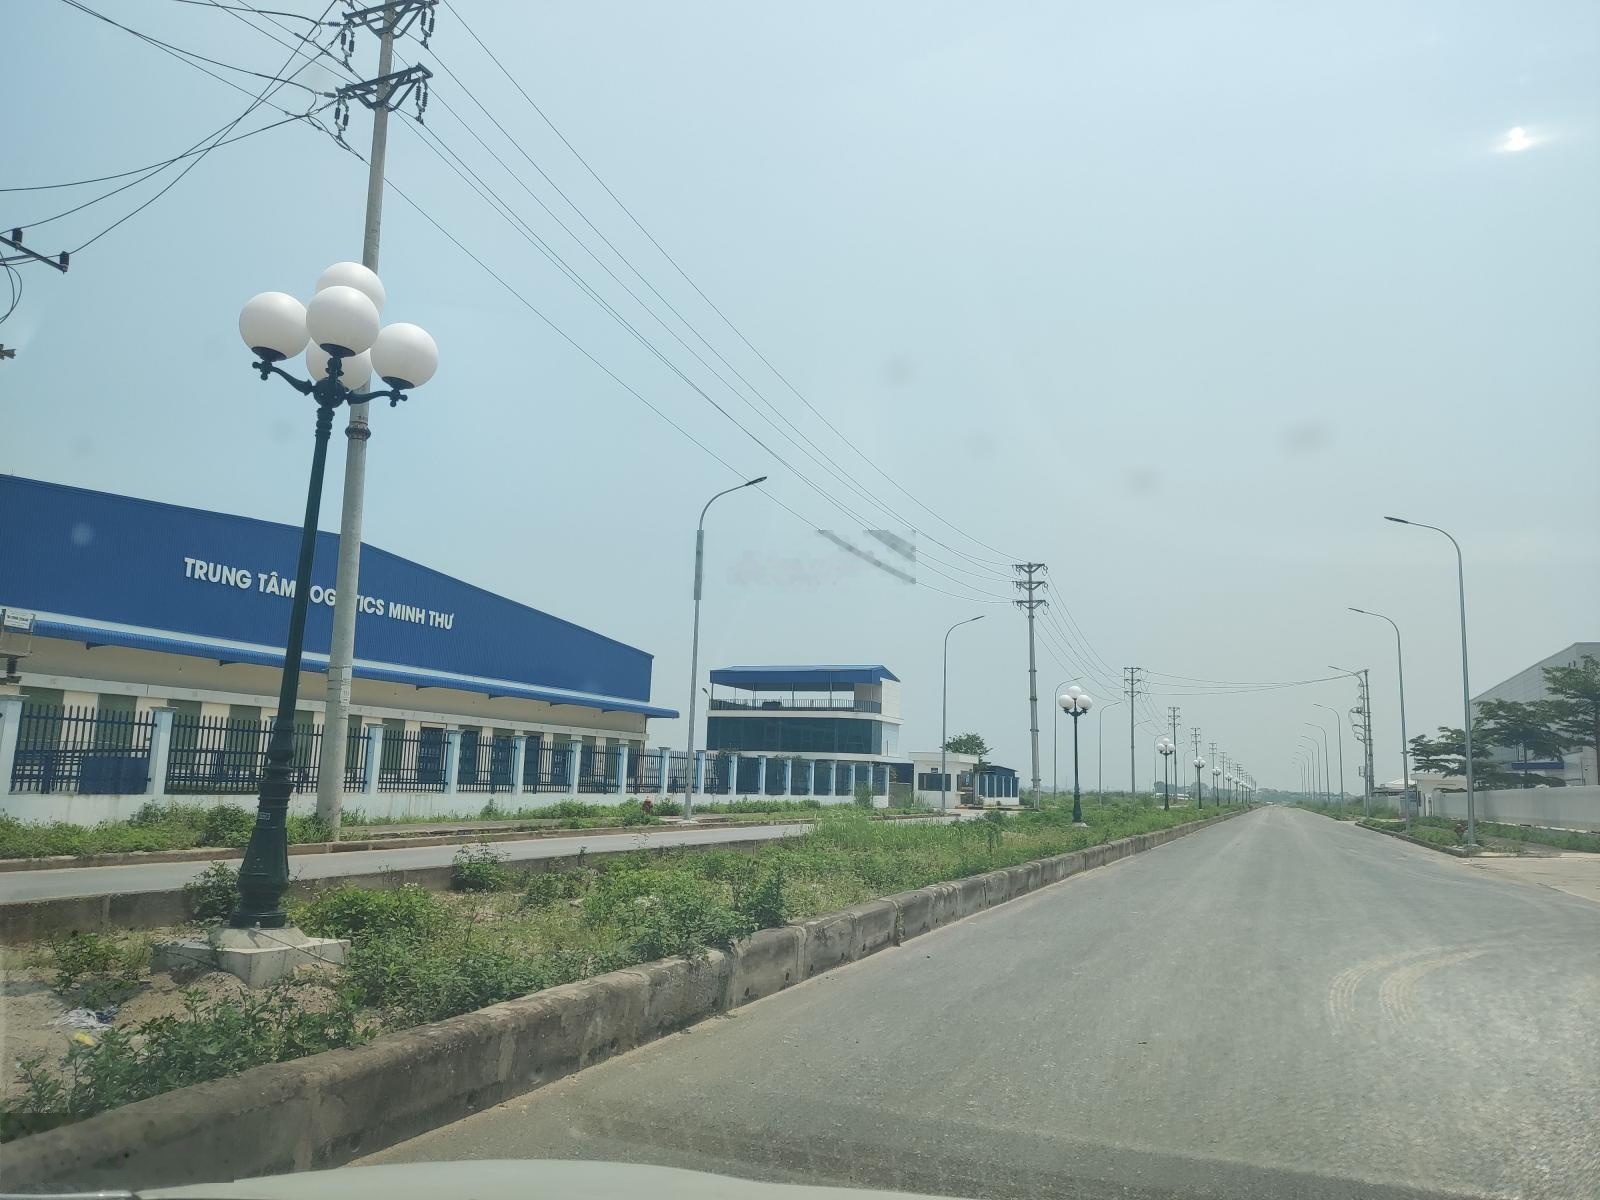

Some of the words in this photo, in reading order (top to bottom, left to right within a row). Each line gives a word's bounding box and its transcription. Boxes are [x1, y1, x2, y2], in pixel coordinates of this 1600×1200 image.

[184, 557, 252, 589] TRUNG
[258, 571, 297, 598] TÂM
[310, 585, 385, 616] OGICS
[388, 601, 426, 625] MINH
